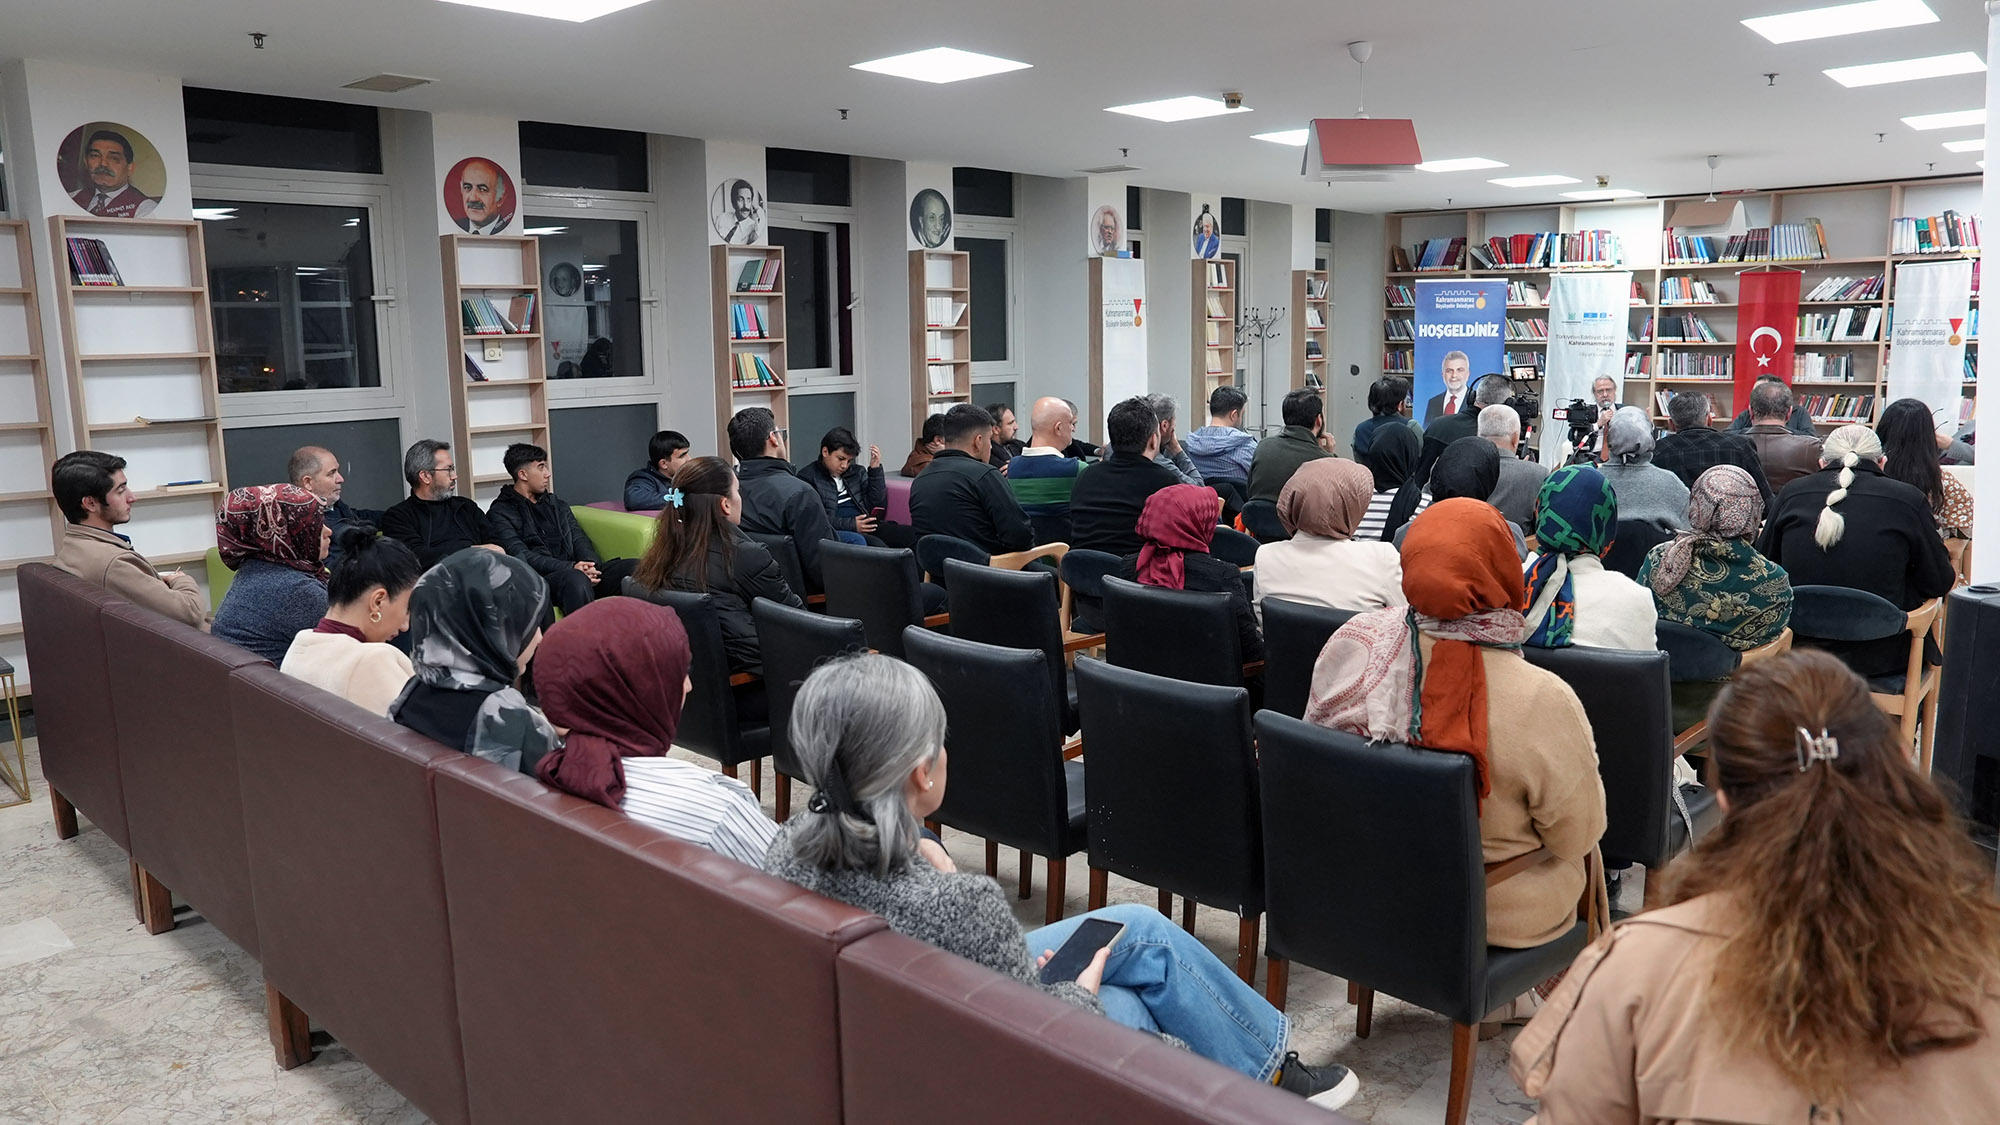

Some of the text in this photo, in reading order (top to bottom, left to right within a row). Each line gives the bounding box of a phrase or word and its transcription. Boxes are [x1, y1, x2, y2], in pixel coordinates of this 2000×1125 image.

[1435, 296, 1475, 304] Kahramanmaraş
[1418, 321, 1499, 339] HOŞGELDİNİZ
[1896, 327, 1946, 338] Kahramanmaraş
